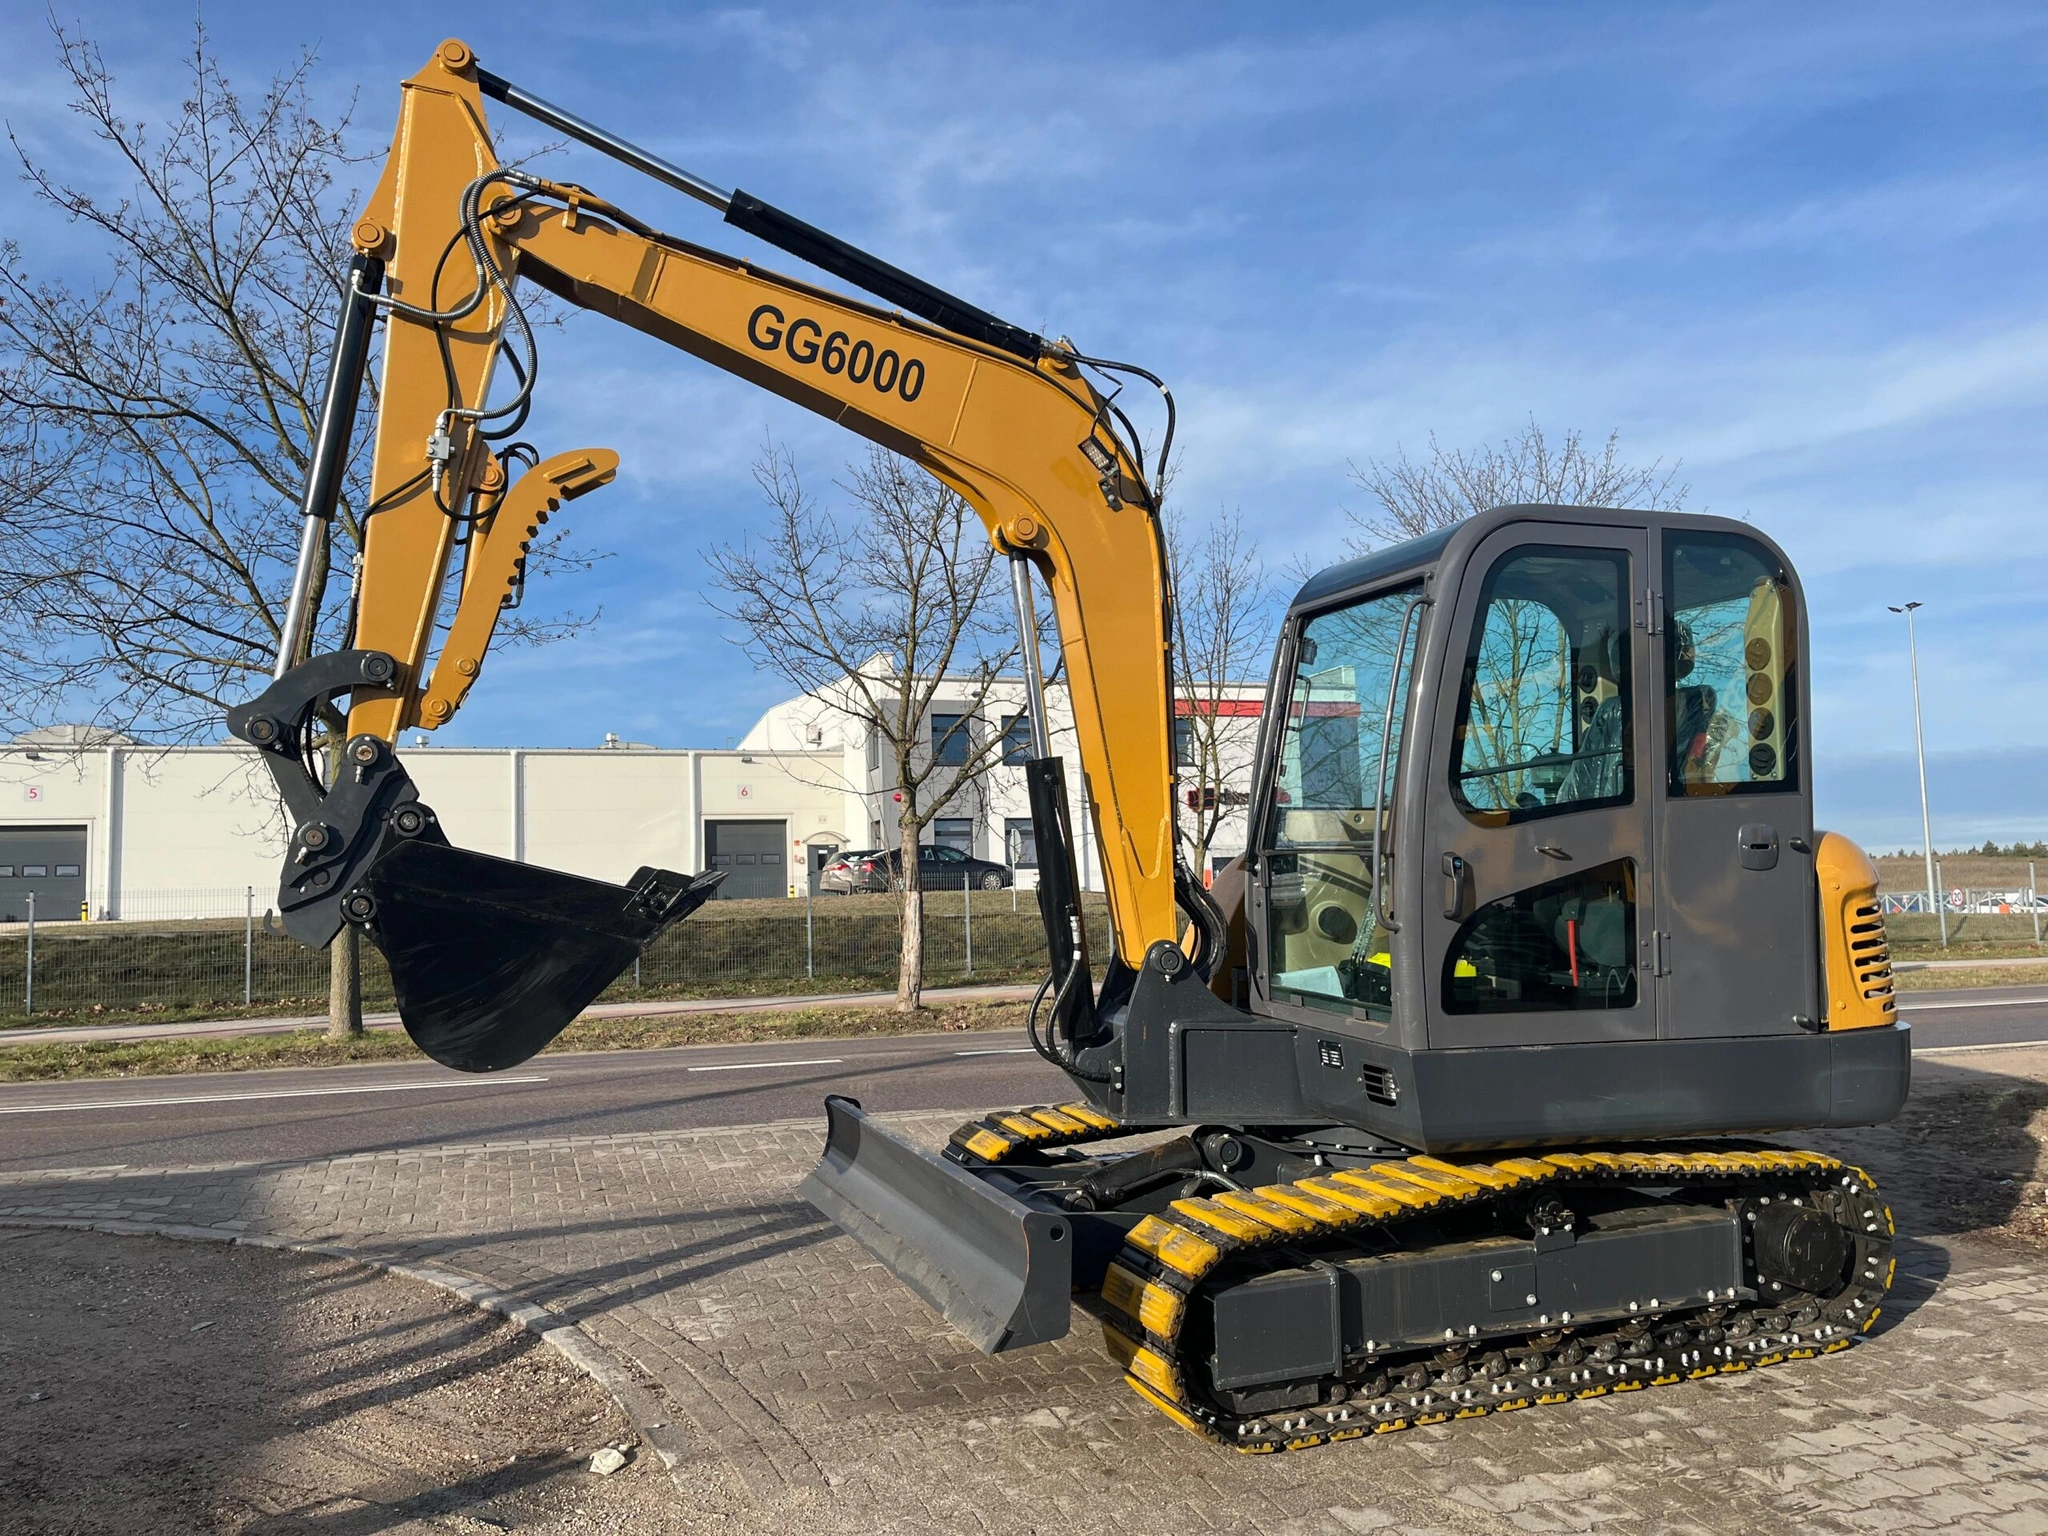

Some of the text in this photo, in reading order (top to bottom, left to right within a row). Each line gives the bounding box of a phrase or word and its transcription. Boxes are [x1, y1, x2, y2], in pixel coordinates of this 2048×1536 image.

[747, 304, 925, 402] GG6000
[29, 787, 38, 799] 5
[741, 786, 748, 797] 6
[1953, 891, 1962, 902] 20
